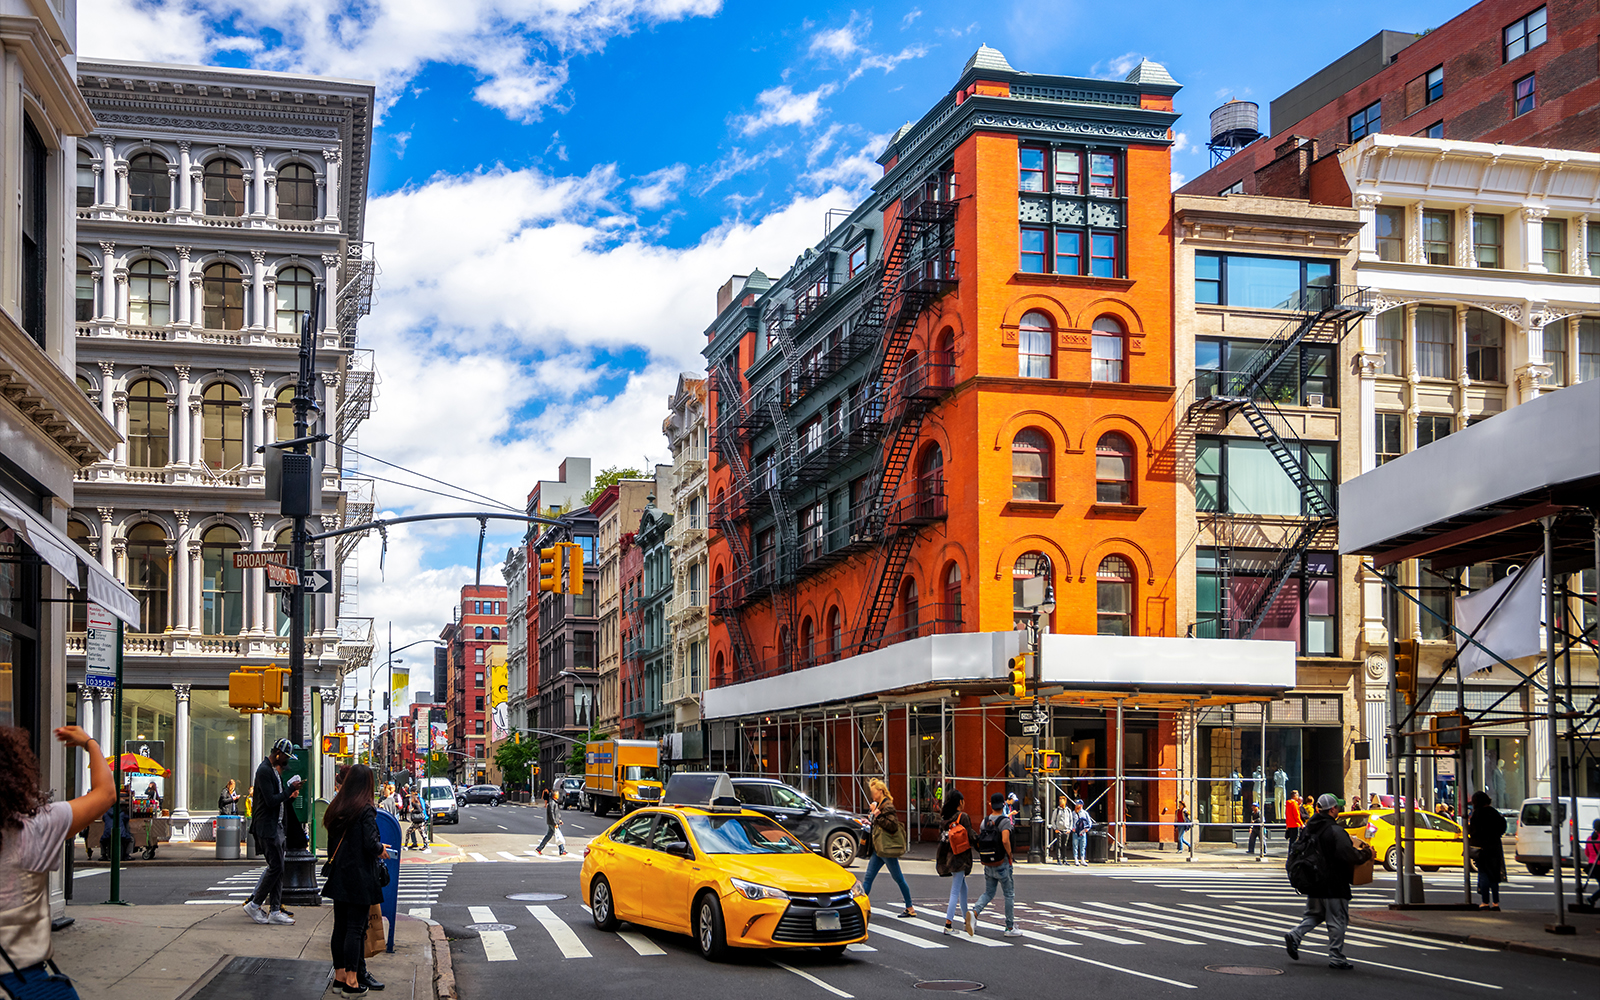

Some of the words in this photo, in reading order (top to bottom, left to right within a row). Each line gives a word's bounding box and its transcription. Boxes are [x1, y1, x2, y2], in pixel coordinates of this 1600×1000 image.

[236, 553, 285, 568] BROADWAY
[289, 569, 297, 583] ST
[88, 629, 95, 639] 2
